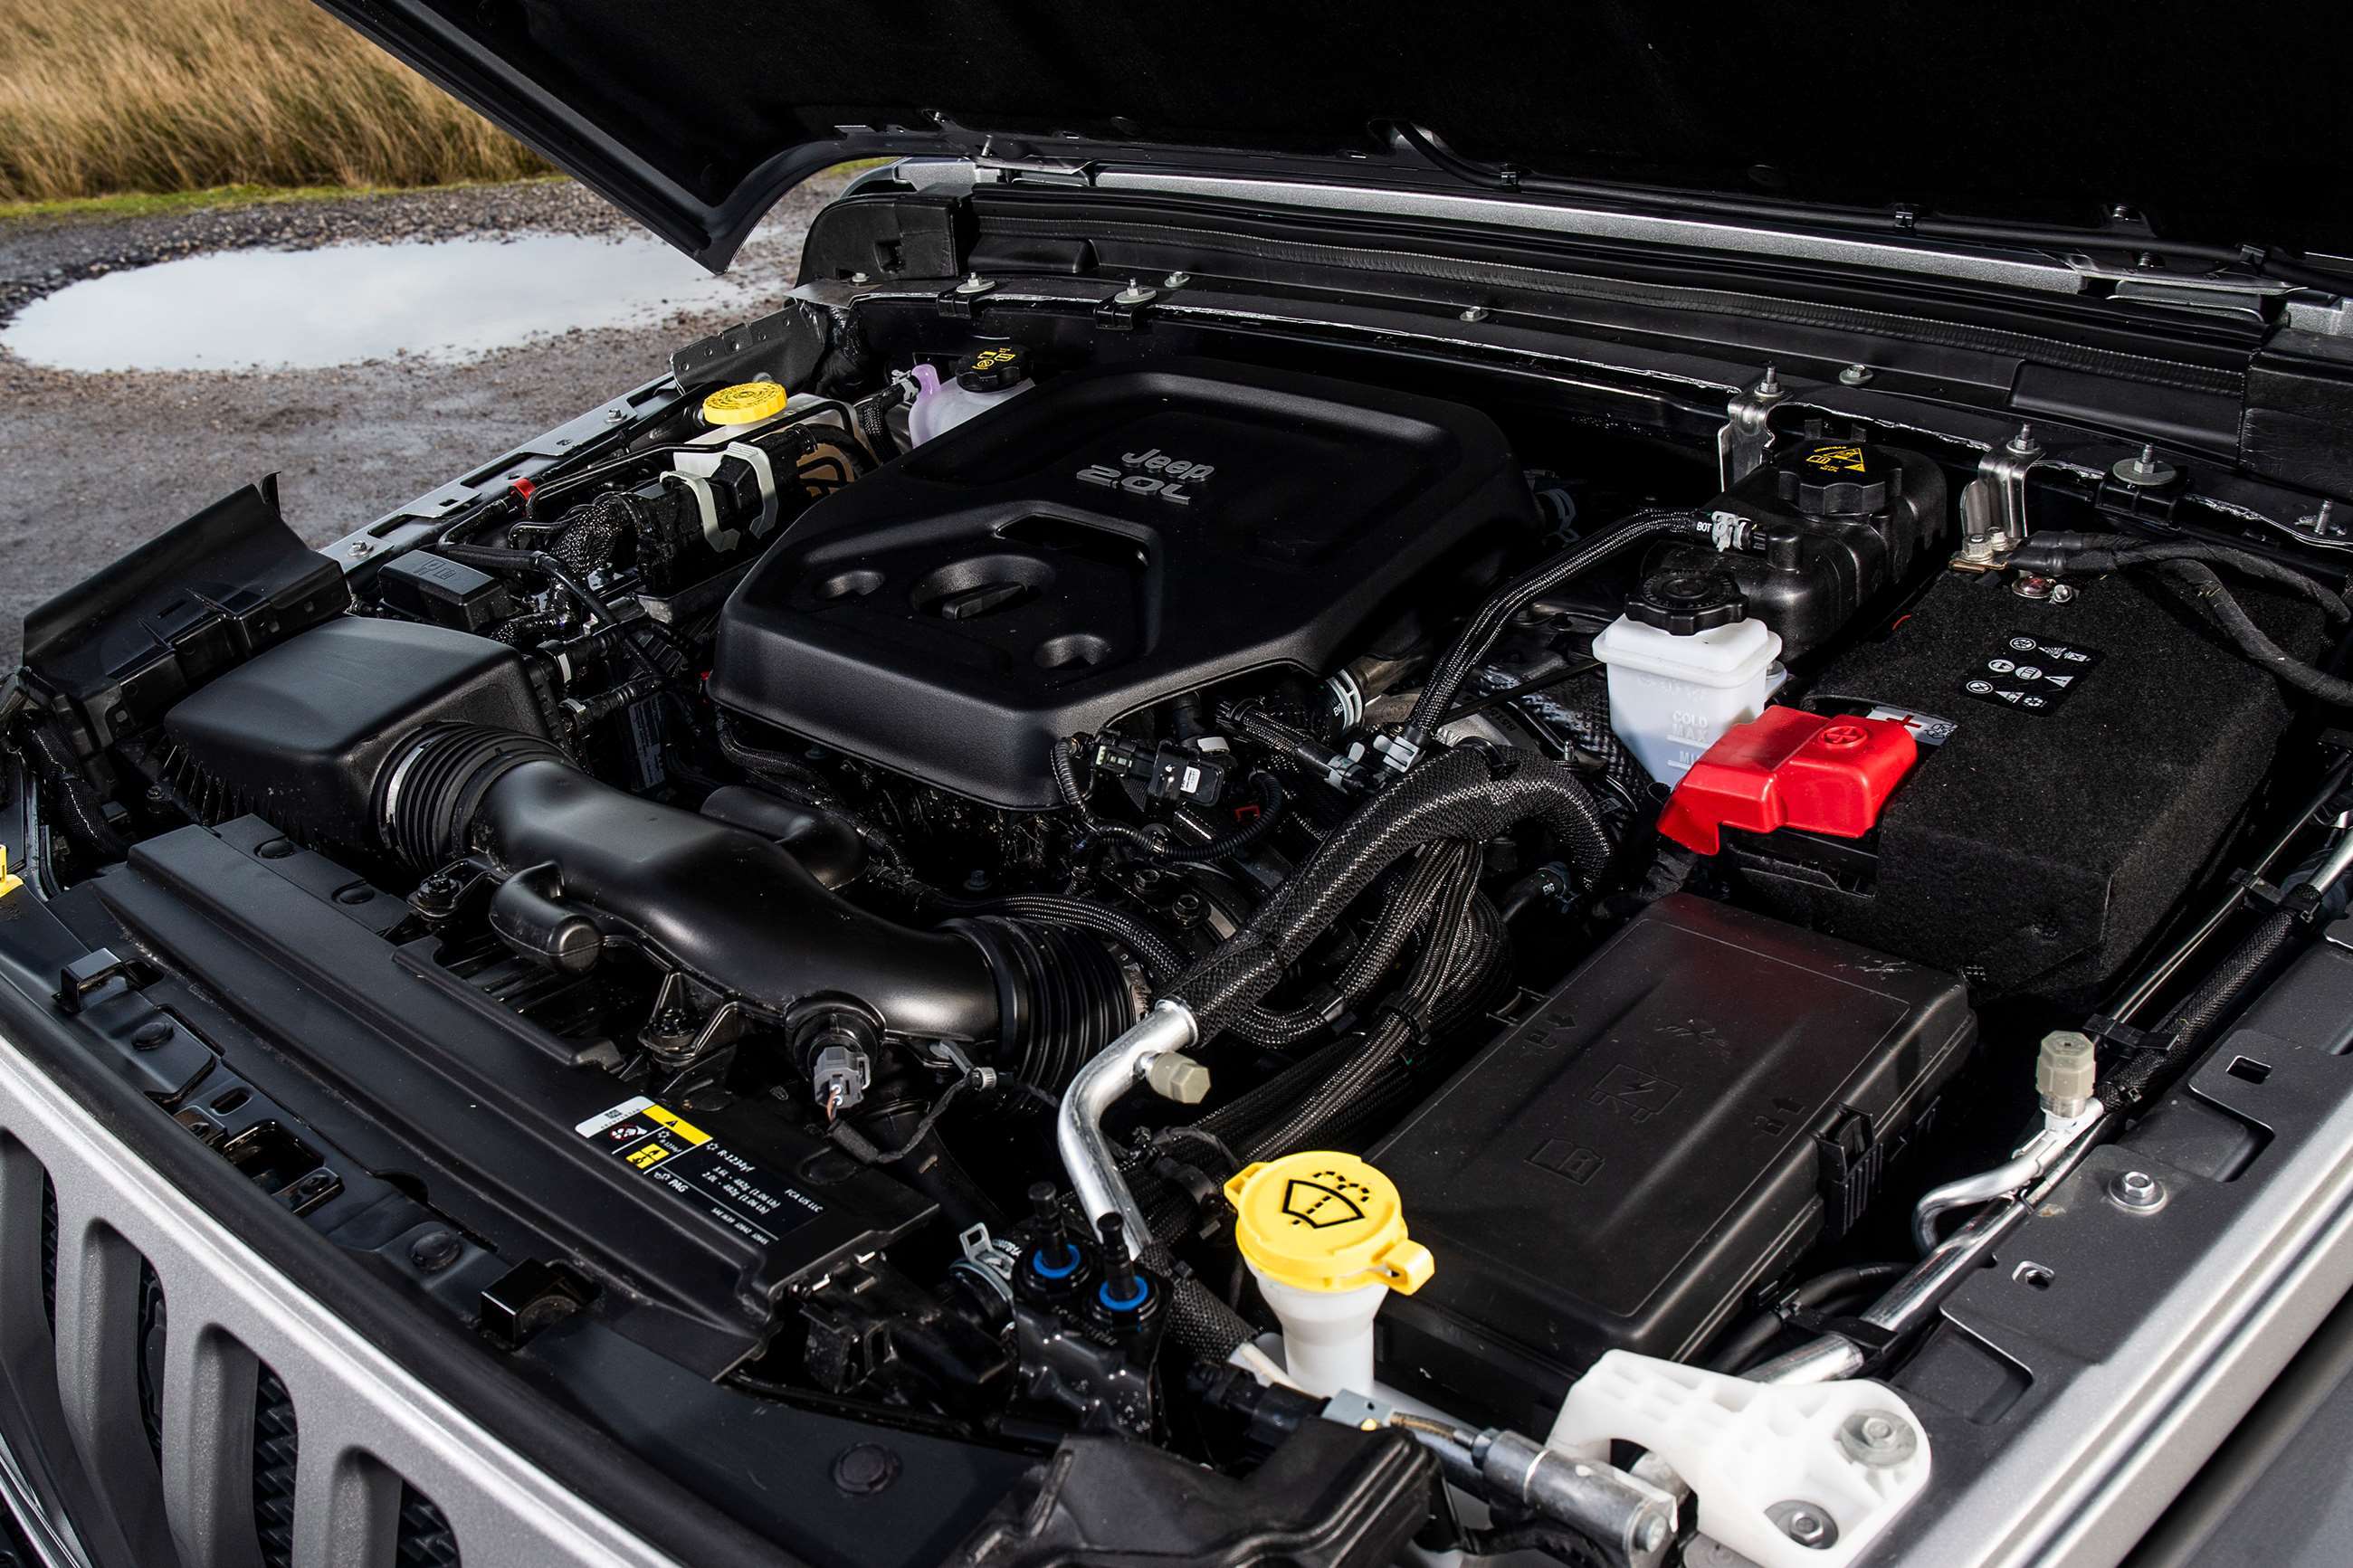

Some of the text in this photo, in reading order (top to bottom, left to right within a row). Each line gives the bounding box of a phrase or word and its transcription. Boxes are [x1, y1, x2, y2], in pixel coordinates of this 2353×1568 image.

[1122, 449, 1215, 482] Jeep
[1076, 464, 1191, 505] 2.0L
[1672, 710, 1708, 728] COLD
[1672, 723, 1708, 741] MAX
[717, 1149, 756, 1173] R-1234yf
[668, 1179, 688, 1193] PAG
[701, 1172, 718, 1183] 2.0L
[785, 1188, 824, 1213] FCA US LLC
